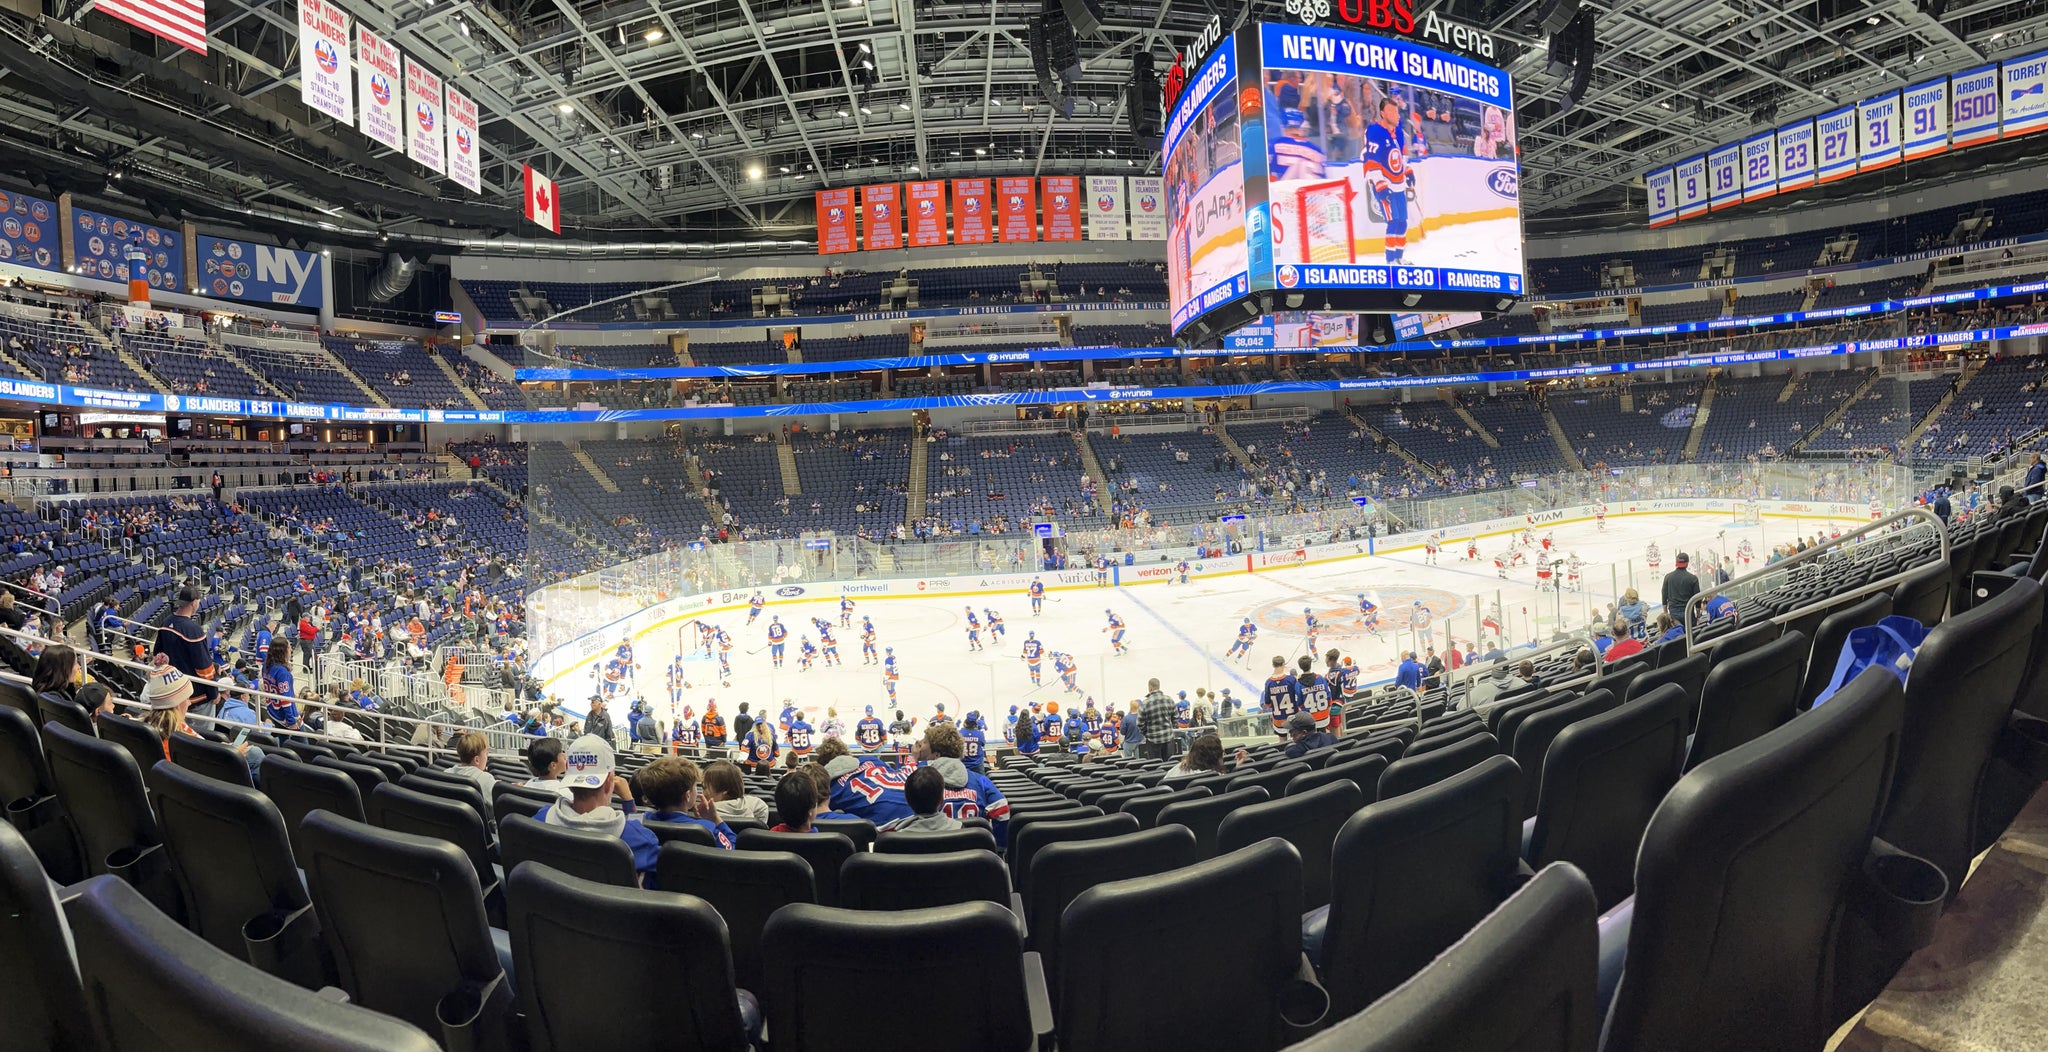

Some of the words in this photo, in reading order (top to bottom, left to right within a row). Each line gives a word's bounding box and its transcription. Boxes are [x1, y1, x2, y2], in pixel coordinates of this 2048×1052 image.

[324, 5, 344, 28] YORK
[303, 10, 346, 46] ISLANDERS
[1338, 0, 1415, 34] UBS
[1423, 10, 1494, 59] Arena
[361, 29, 377, 50] NEW
[379, 41, 397, 63] YORK
[1185, 14, 1221, 78] Arena
[361, 46, 398, 80] ISLANDERS
[408, 62, 421, 80] NEW
[1282, 34, 1335, 63] NEW
[1340, 40, 1399, 73] YORK
[1402, 51, 1499, 97] ISLANDERS
[2007, 62, 2047, 83] TORREY
[408, 78, 440, 107] ISLANDERS
[1181, 53, 1227, 126] ISLANDERS
[1956, 76, 1994, 96] ARBOUR
[312, 94, 344, 118] CHAMPIONS
[1908, 88, 1943, 109] GORING
[1954, 92, 1996, 123] 1500
[449, 104, 476, 132] ISLANDERS
[1866, 103, 1893, 121] SMITH
[1914, 105, 1938, 136] 91
[1820, 115, 1852, 136] TONELLI
[1869, 119, 1890, 149] 31
[1779, 128, 1812, 146] NYSTROM
[1824, 131, 1848, 161] 27
[1710, 151, 1738, 168] TROTTIER
[1746, 141, 1770, 158] BOSSY
[1784, 143, 1808, 172] 23
[1679, 163, 1702, 179] GILLIES
[1748, 154, 1770, 182] 22
[1650, 174, 1671, 189] POTVIN
[1687, 177, 1697, 199] 9
[1716, 166, 1733, 191] 19
[1656, 187, 1666, 209] 5
[1969, 242, 1986, 250] HALL
[2000, 237, 2018, 246] FAME
[256, 244, 318, 304] NY
[1304, 267, 1387, 285] ISLANDERS
[1397, 269, 1434, 286] 6:30
[1448, 272, 1500, 289] RANGERS
[1204, 283, 1232, 308] RANGERS
[2012, 283, 2044, 293] EXPERIENCE
[959, 307, 980, 315] JOHN
[983, 305, 1011, 313] TONELLI
[1235, 337, 1264, 347] $8,042
[1860, 339, 1899, 350] ISLANDERS
[1907, 336, 1926, 346] 6:27
[1937, 333, 1974, 343] RANGERS
[1729, 354, 1745, 362] YORK
[1745, 352, 1776, 360] ISLANDERS
[186, 397, 241, 412] ISLANDERS
[251, 401, 273, 414] 6:51
[287, 404, 325, 417] RANGERS
[1534, 511, 1563, 522] VIAM
[1839, 505, 1856, 514] UBS
[1138, 566, 1172, 578] verizon
[781, 587, 801, 597] Ford
[843, 584, 888, 592] Northwell
[653, 608, 666, 620] UBS
[1270, 685, 1288, 695] HORVAT
[1301, 684, 1325, 695] SCHAEFER
[1270, 693, 1294, 715] 14
[1304, 691, 1329, 713] 48
[1049, 726, 1061, 736] 91
[1088, 721, 1099, 731] 11
[682, 732, 696, 743] 31
[792, 733, 808, 747] 28
[862, 729, 879, 744] 48
[1103, 735, 1113, 745] 48
